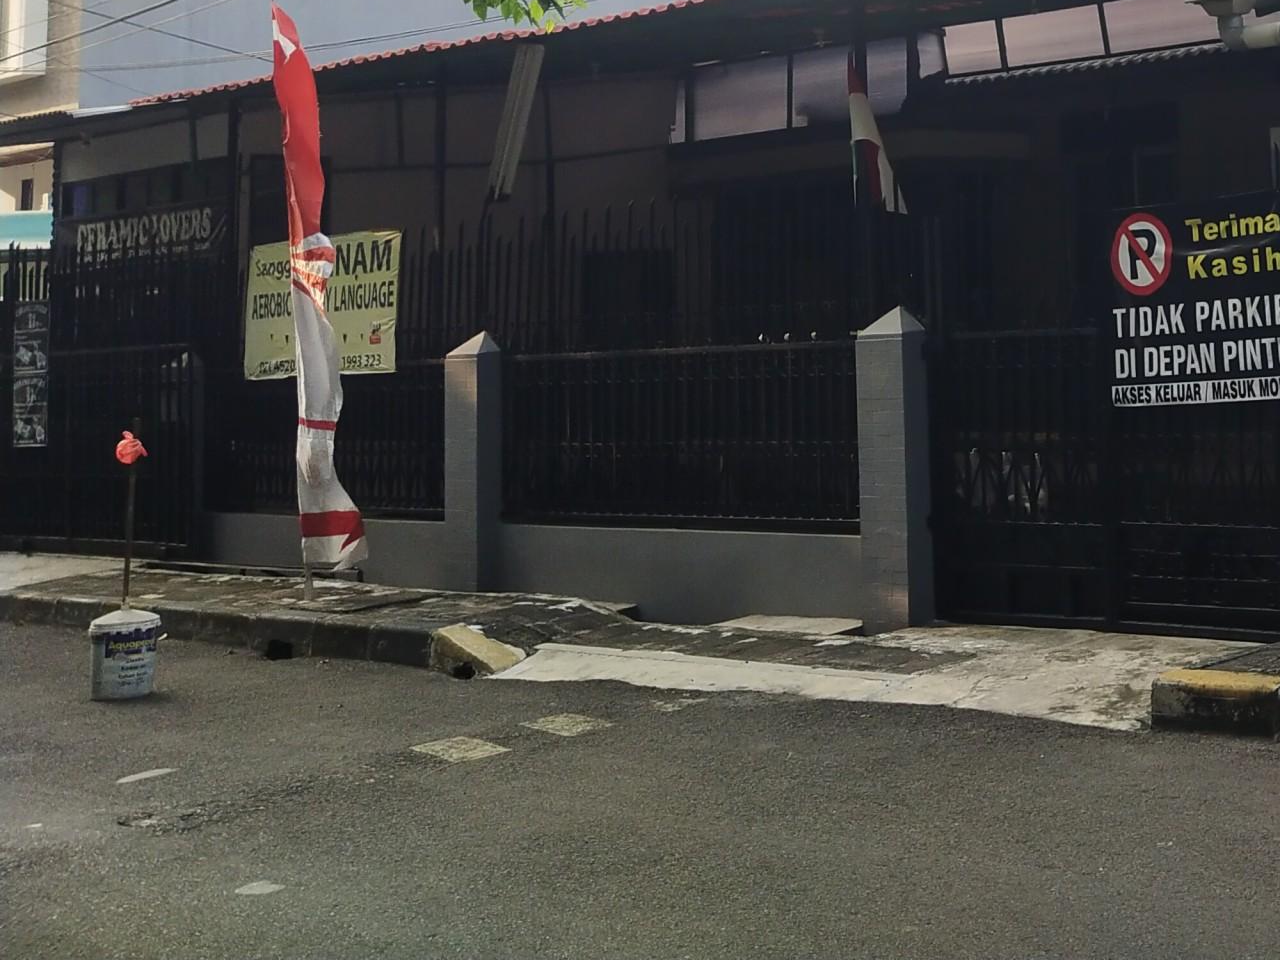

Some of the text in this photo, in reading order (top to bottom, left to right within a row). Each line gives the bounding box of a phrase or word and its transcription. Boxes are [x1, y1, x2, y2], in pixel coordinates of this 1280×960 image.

[1185, 212, 1280, 242] Terima
[256, 239, 393, 280] Sangg NAM
[252, 291, 292, 320] AEROBIC
[334, 281, 395, 312] LANGUAGE
[1113, 303, 1186, 338] TIDAK
[364, 353, 382, 367] 323
[1114, 348, 1137, 379] DI
[1144, 342, 1216, 378] DEPAN
[1114, 386, 1152, 405] AKSES
[1154, 383, 1202, 404] KELUAR
[1212, 379, 1256, 400] MASUK
